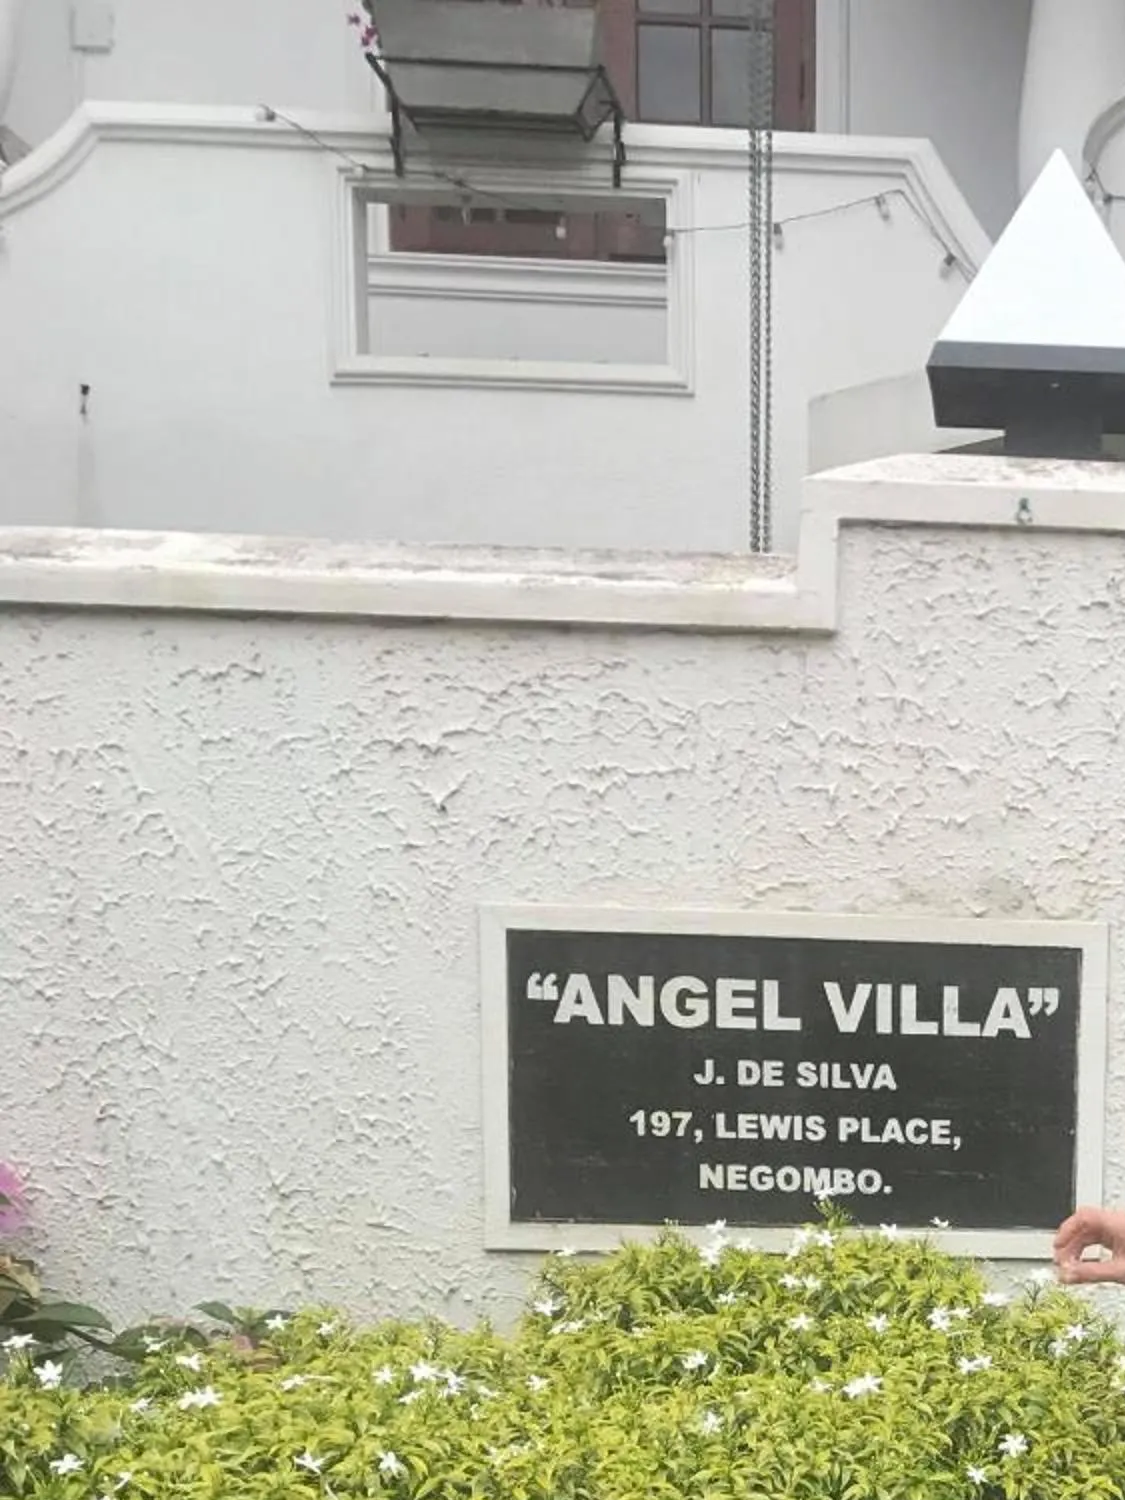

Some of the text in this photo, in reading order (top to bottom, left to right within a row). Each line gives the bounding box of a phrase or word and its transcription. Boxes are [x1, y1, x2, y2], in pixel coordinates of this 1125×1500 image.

[526, 972, 1060, 1039] “ANGEL VILLA”
[693, 1059, 897, 1091] J. DE SILVA
[629, 1109, 962, 1151] 197, LEWIS PLACE,
[699, 1163, 892, 1196] NEGOMBO.
